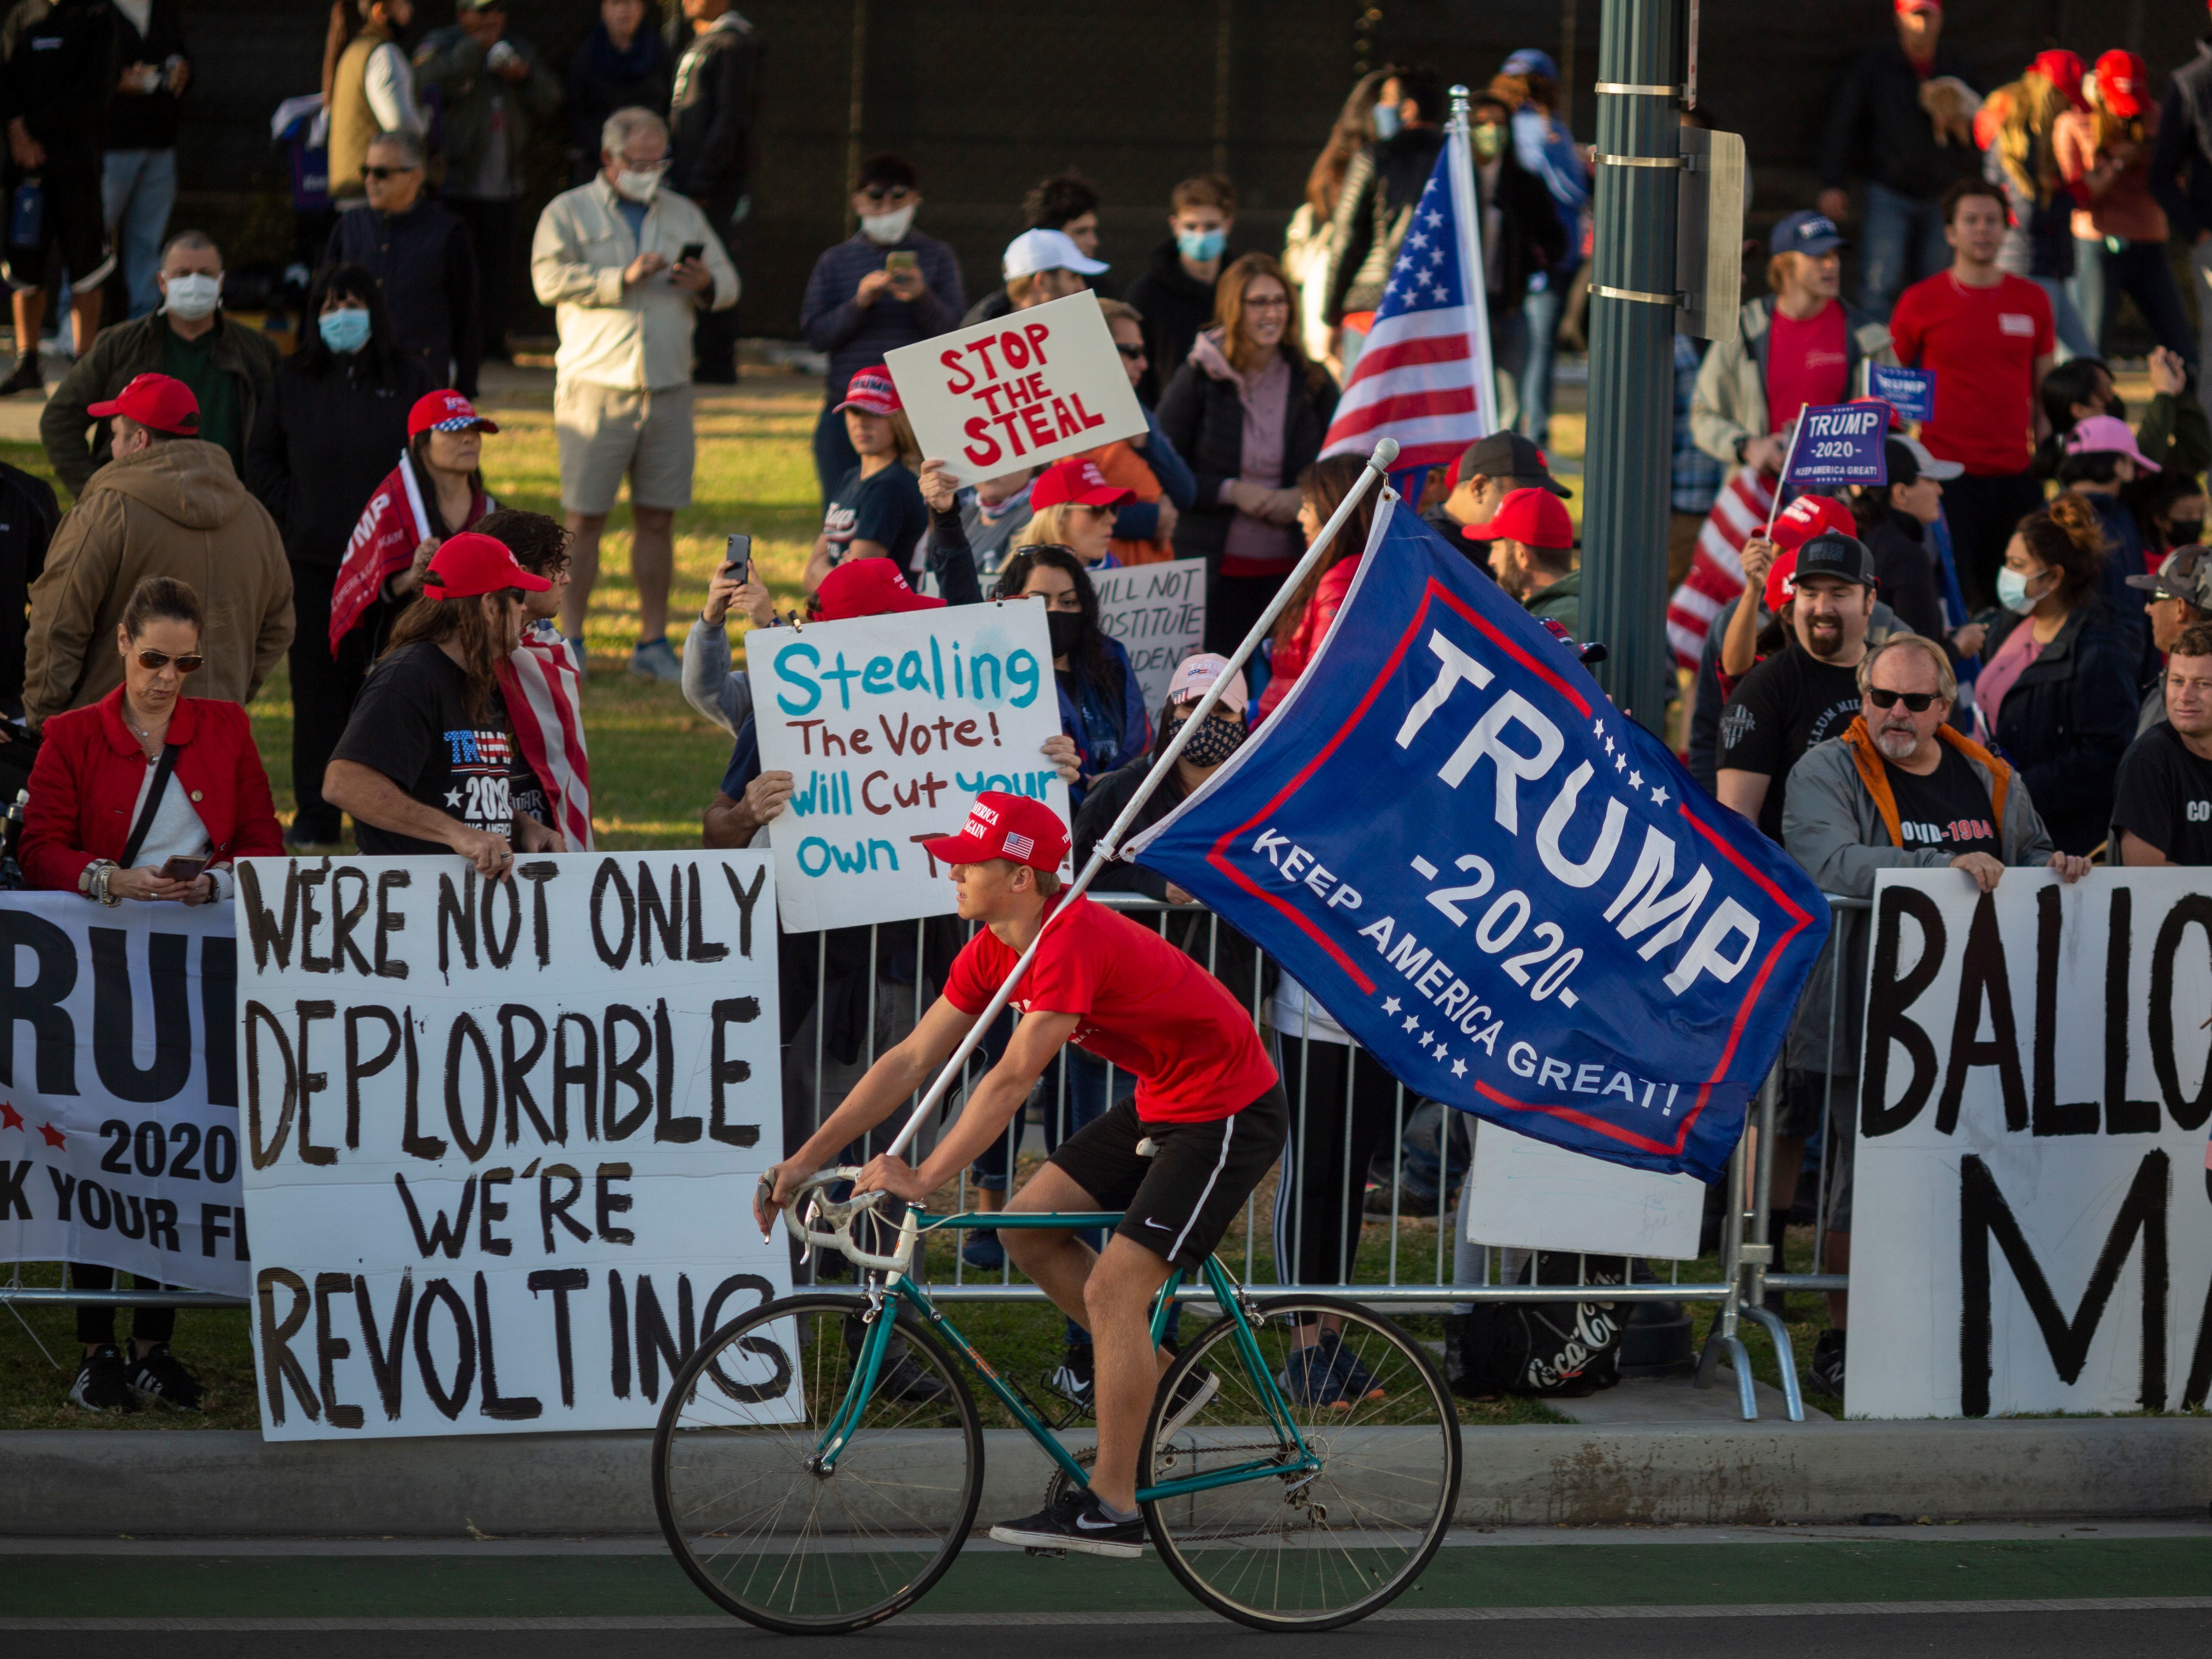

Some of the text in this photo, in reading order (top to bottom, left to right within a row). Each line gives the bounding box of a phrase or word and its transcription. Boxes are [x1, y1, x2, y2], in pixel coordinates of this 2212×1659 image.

[940, 323, 1049, 395] STOP
[972, 371, 1053, 416] THE
[1809, 412, 1879, 438] TRUMP
[964, 393, 1105, 466] STEAL
[1811, 441, 1862, 458] -2020-
[1812, 465, 1845, 475] AMERICA
[1847, 466, 1877, 475] GREAT!
[1147, 568, 1201, 601] NOT
[1099, 603, 1204, 638] OSTITUTE
[773, 635, 1040, 716] Stealing
[443, 729, 512, 764] TRUM
[786, 712, 1002, 757] The Vote!
[862, 770, 948, 815] Cut
[971, 800, 1000, 826] MERICA
[1395, 628, 1760, 996] TRUMP
[2186, 800, 2212, 822] CO
[797, 836, 899, 877] Own
[1901, 819, 1994, 844] OVID-1984
[236, 855, 765, 986] WE'RE NOT ONLY
[1409, 853, 1584, 1009] -2020-
[1252, 828, 1680, 1116] KEEP AMERICA GREAT!
[0, 908, 238, 1108] RU
[1861, 884, 2212, 1139] BALLO
[243, 995, 761, 1170] DEPLORABLE
[100, 1119, 237, 1184] 2020
[47, 1164, 181, 1253] YOUR
[394, 1157, 635, 1259] WE'RE
[257, 1266, 792, 1430] REVOLTING
